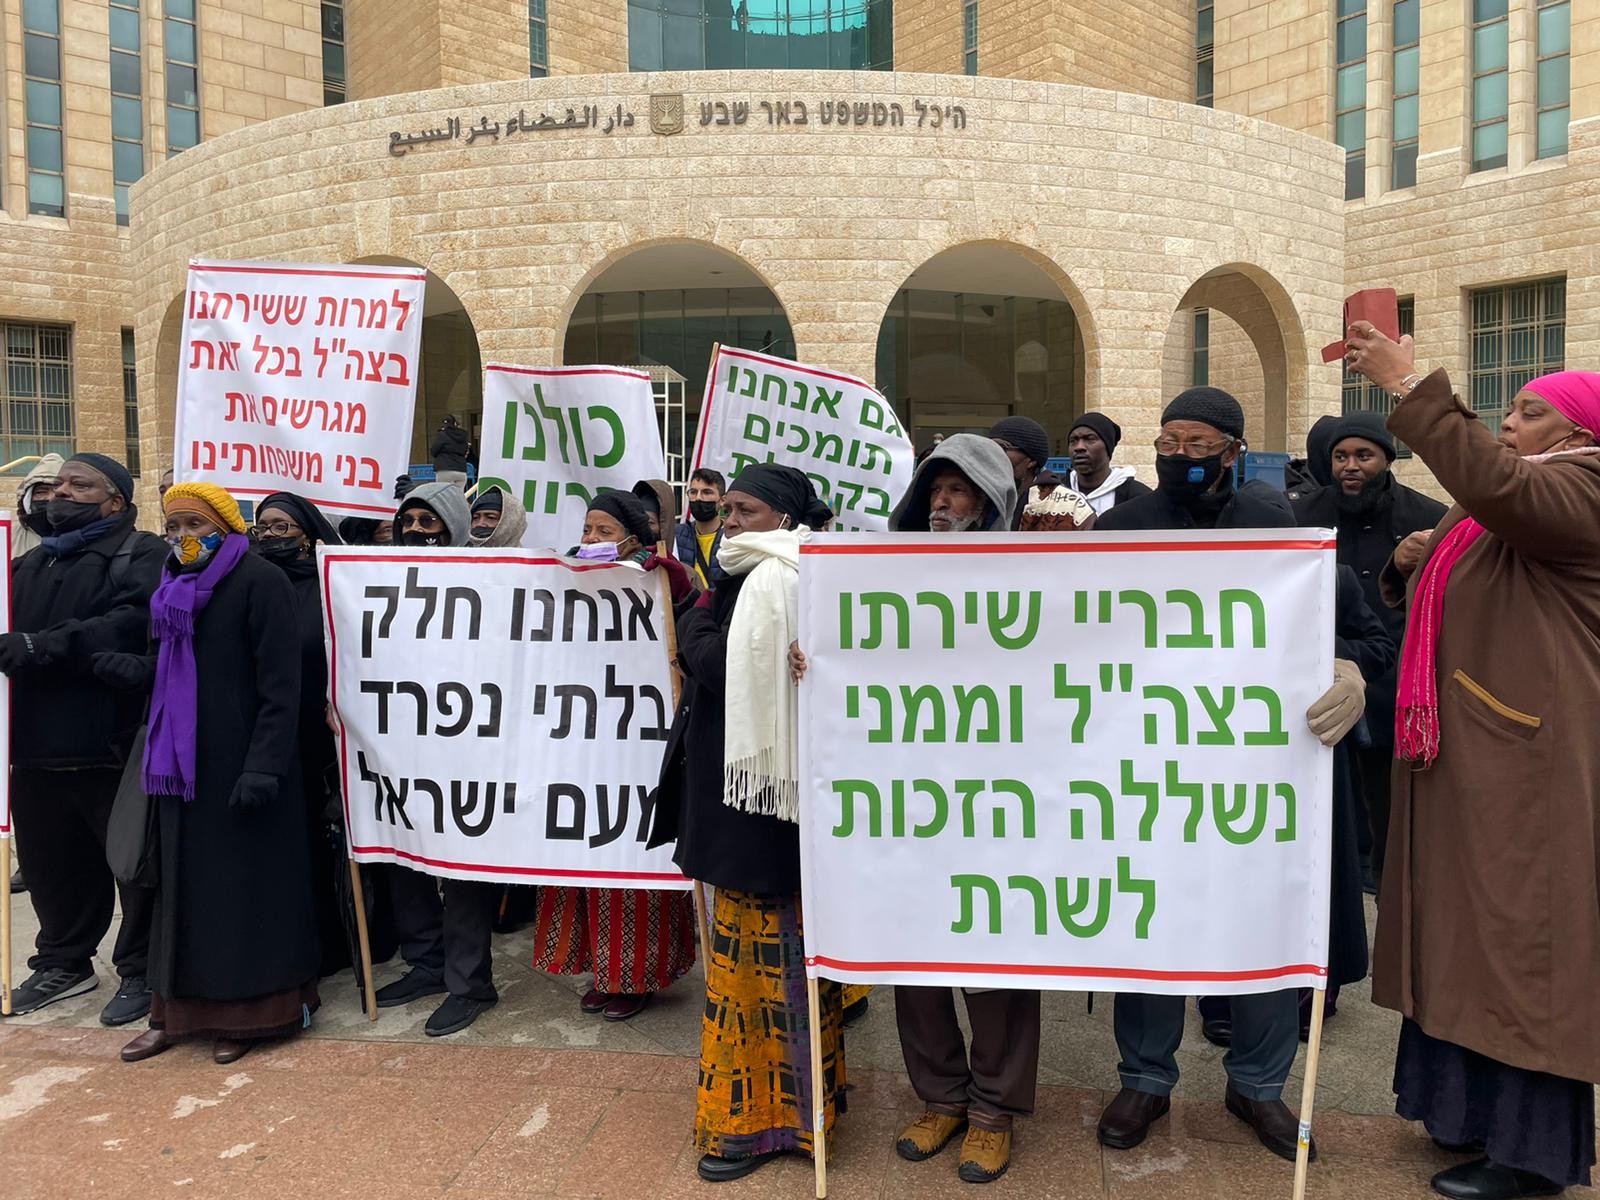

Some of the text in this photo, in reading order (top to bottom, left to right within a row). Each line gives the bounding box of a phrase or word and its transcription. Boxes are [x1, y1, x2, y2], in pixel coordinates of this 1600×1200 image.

[388, 104, 635, 157] دار القضاء بئر السبع
[699, 99, 967, 130] היכל המשפט באר שבע
[188, 289, 411, 331] למרות ששירתנו
[189, 335, 410, 387] בצה"ל בכל זאת
[262, 394, 367, 435] מגרשים
[501, 383, 625, 469] כולנו
[727, 365, 902, 438] גם אנחנו
[191, 440, 383, 490] בני משפחותינו
[742, 412, 893, 475] תומכים
[361, 567, 658, 659] אנחנו חלק
[838, 588, 1267, 650] חבריי שירתו
[360, 664, 671, 741] בלתי נפרד
[846, 662, 1290, 746] בצה"ל וממני
[357, 750, 517, 838] ישראל
[831, 758, 1297, 846] נשללה הזכות
[950, 855, 1157, 940] לשרת
